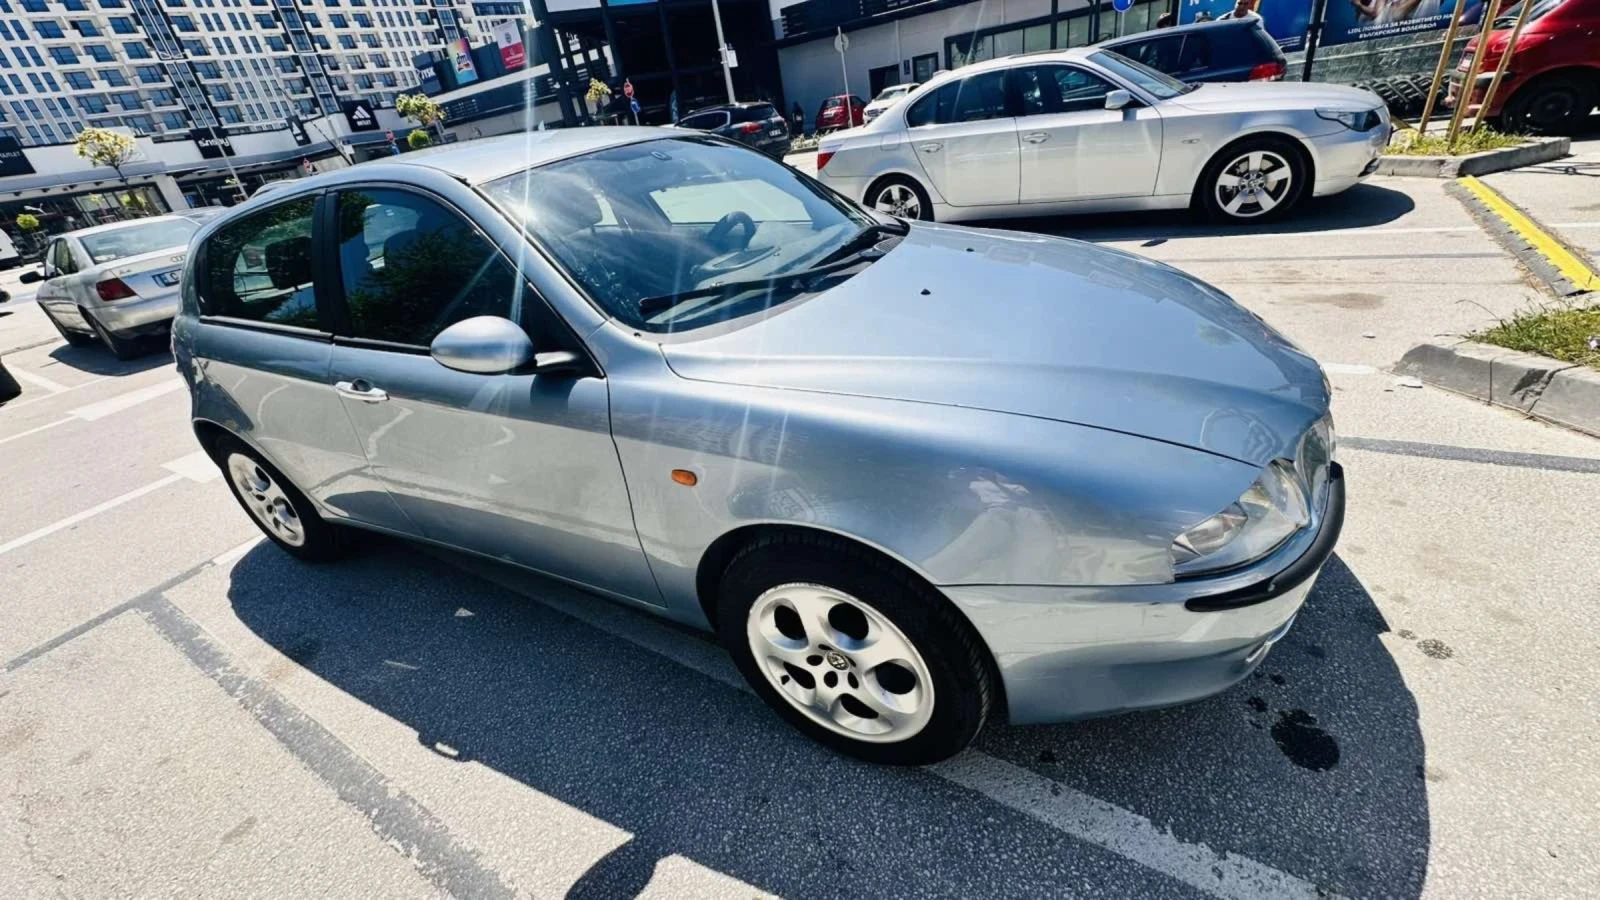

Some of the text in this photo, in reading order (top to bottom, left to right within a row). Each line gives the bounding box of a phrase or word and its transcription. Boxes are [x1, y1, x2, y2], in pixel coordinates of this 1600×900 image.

[1359, 22, 1437, 39] БЪЛГАРСКИЯ ВОЛЕЙБОЛ
[1362, 23, 1389, 32] ПОМАГА
[1399, 15, 1442, 26] РАЗВИТИЕТО
[421, 66, 437, 80] JYSK
